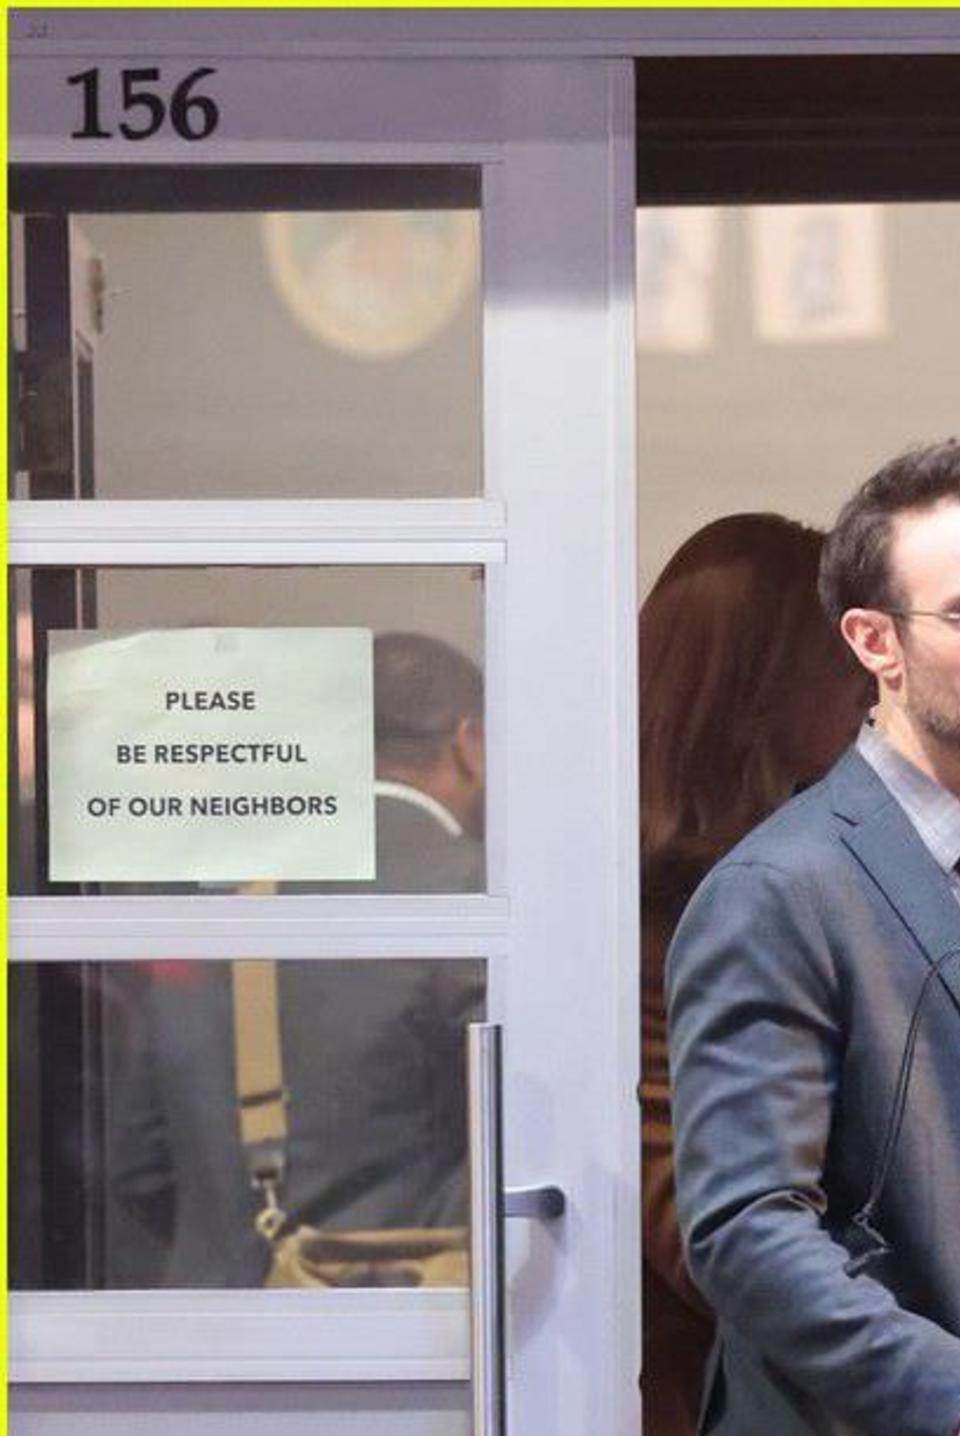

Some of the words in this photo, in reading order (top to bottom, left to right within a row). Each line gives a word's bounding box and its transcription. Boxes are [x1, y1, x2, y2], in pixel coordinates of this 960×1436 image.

[66, 67, 220, 140] 156
[165, 691, 256, 711] PLEASE
[116, 744, 147, 764] BE
[154, 744, 307, 764] RESPECTFUL
[87, 796, 119, 816] OF
[128, 796, 183, 817] OUR
[190, 796, 338, 816] NEIGHBORS
